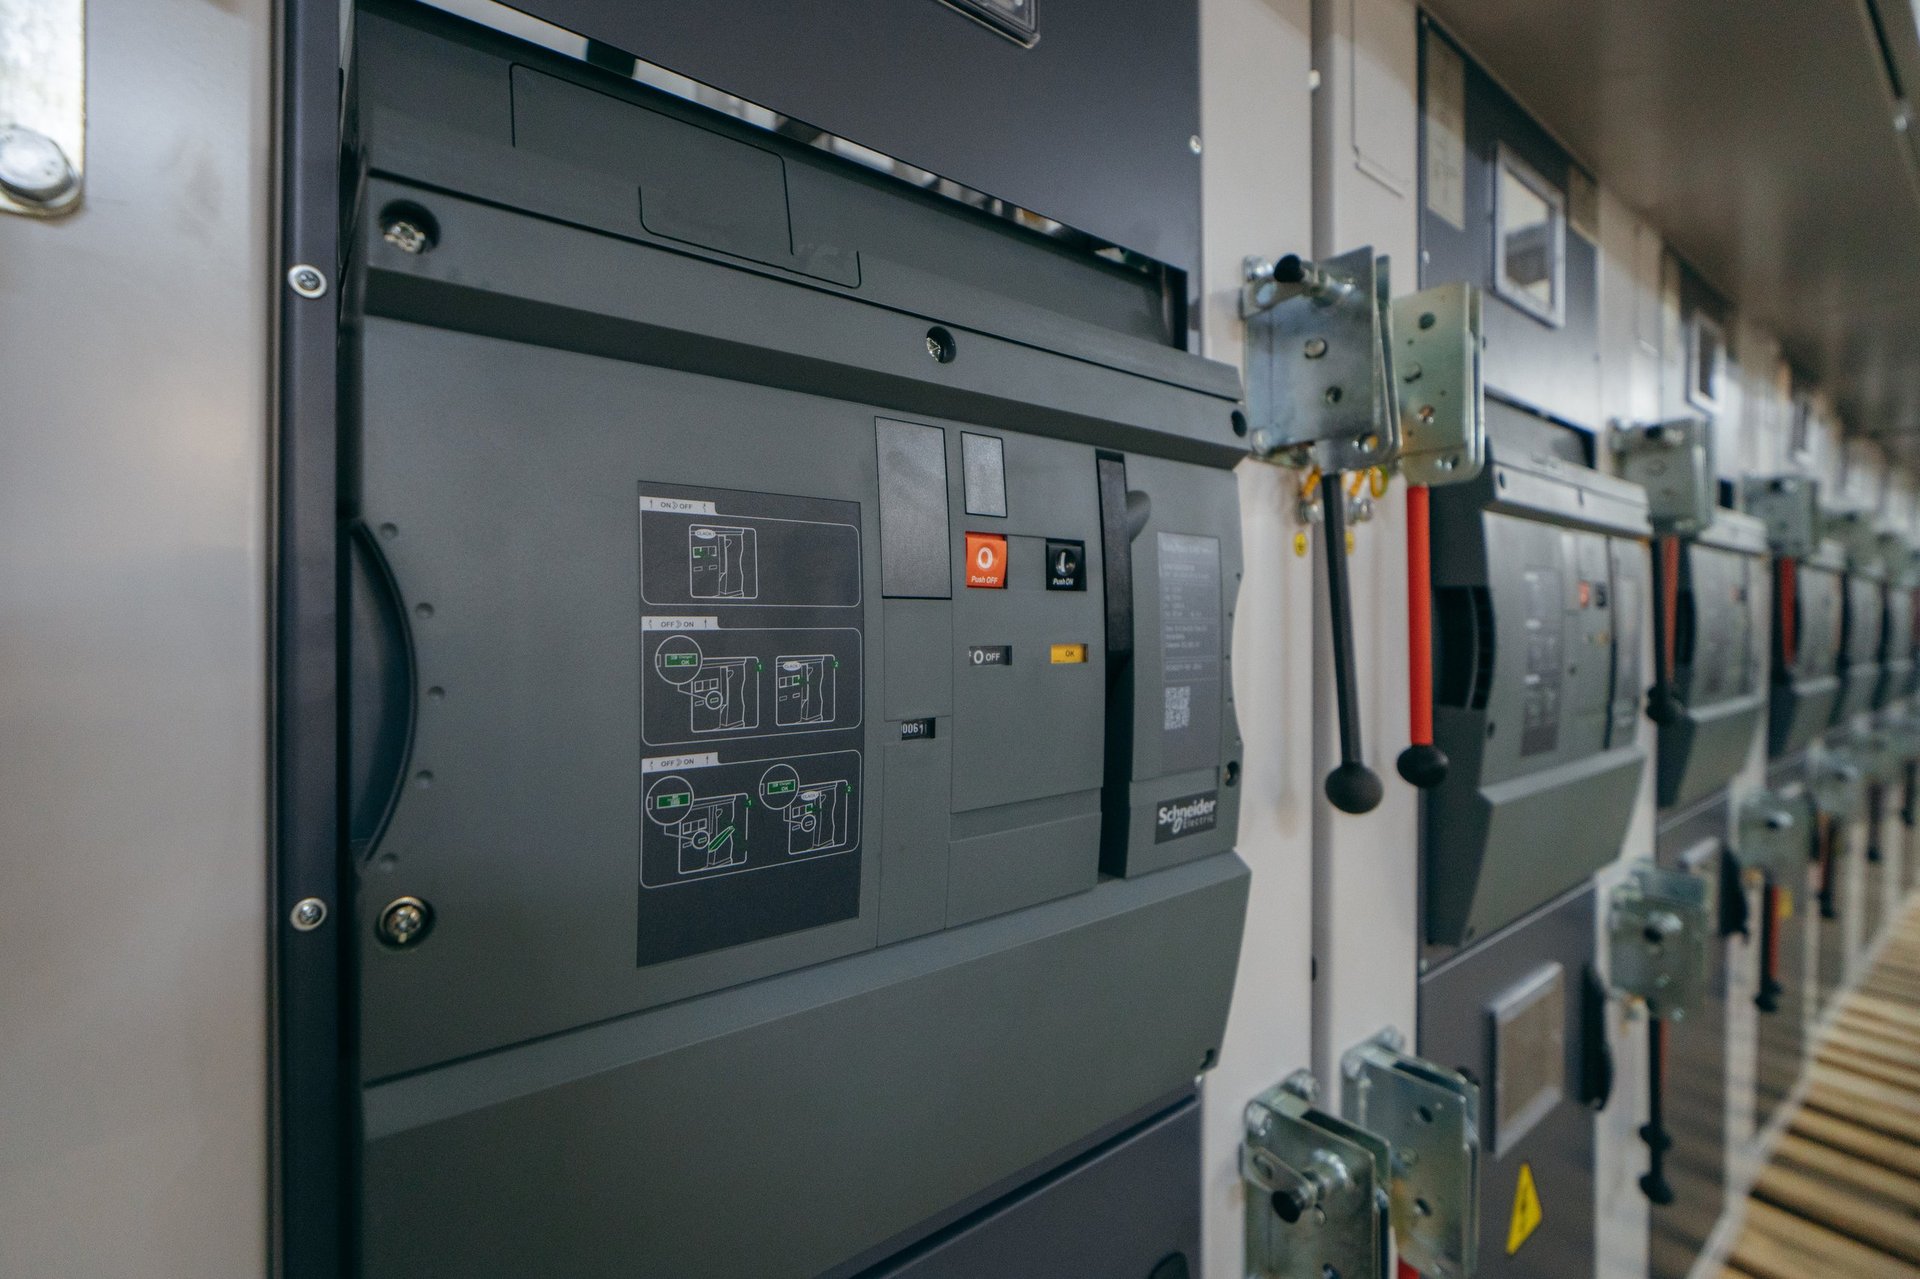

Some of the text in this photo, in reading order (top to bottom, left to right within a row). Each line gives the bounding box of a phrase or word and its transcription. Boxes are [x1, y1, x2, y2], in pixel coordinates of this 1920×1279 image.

[971, 575, 998, 584] Push OFF
[985, 652, 1001, 661] OFF
[1158, 798, 1217, 834] Schneider
